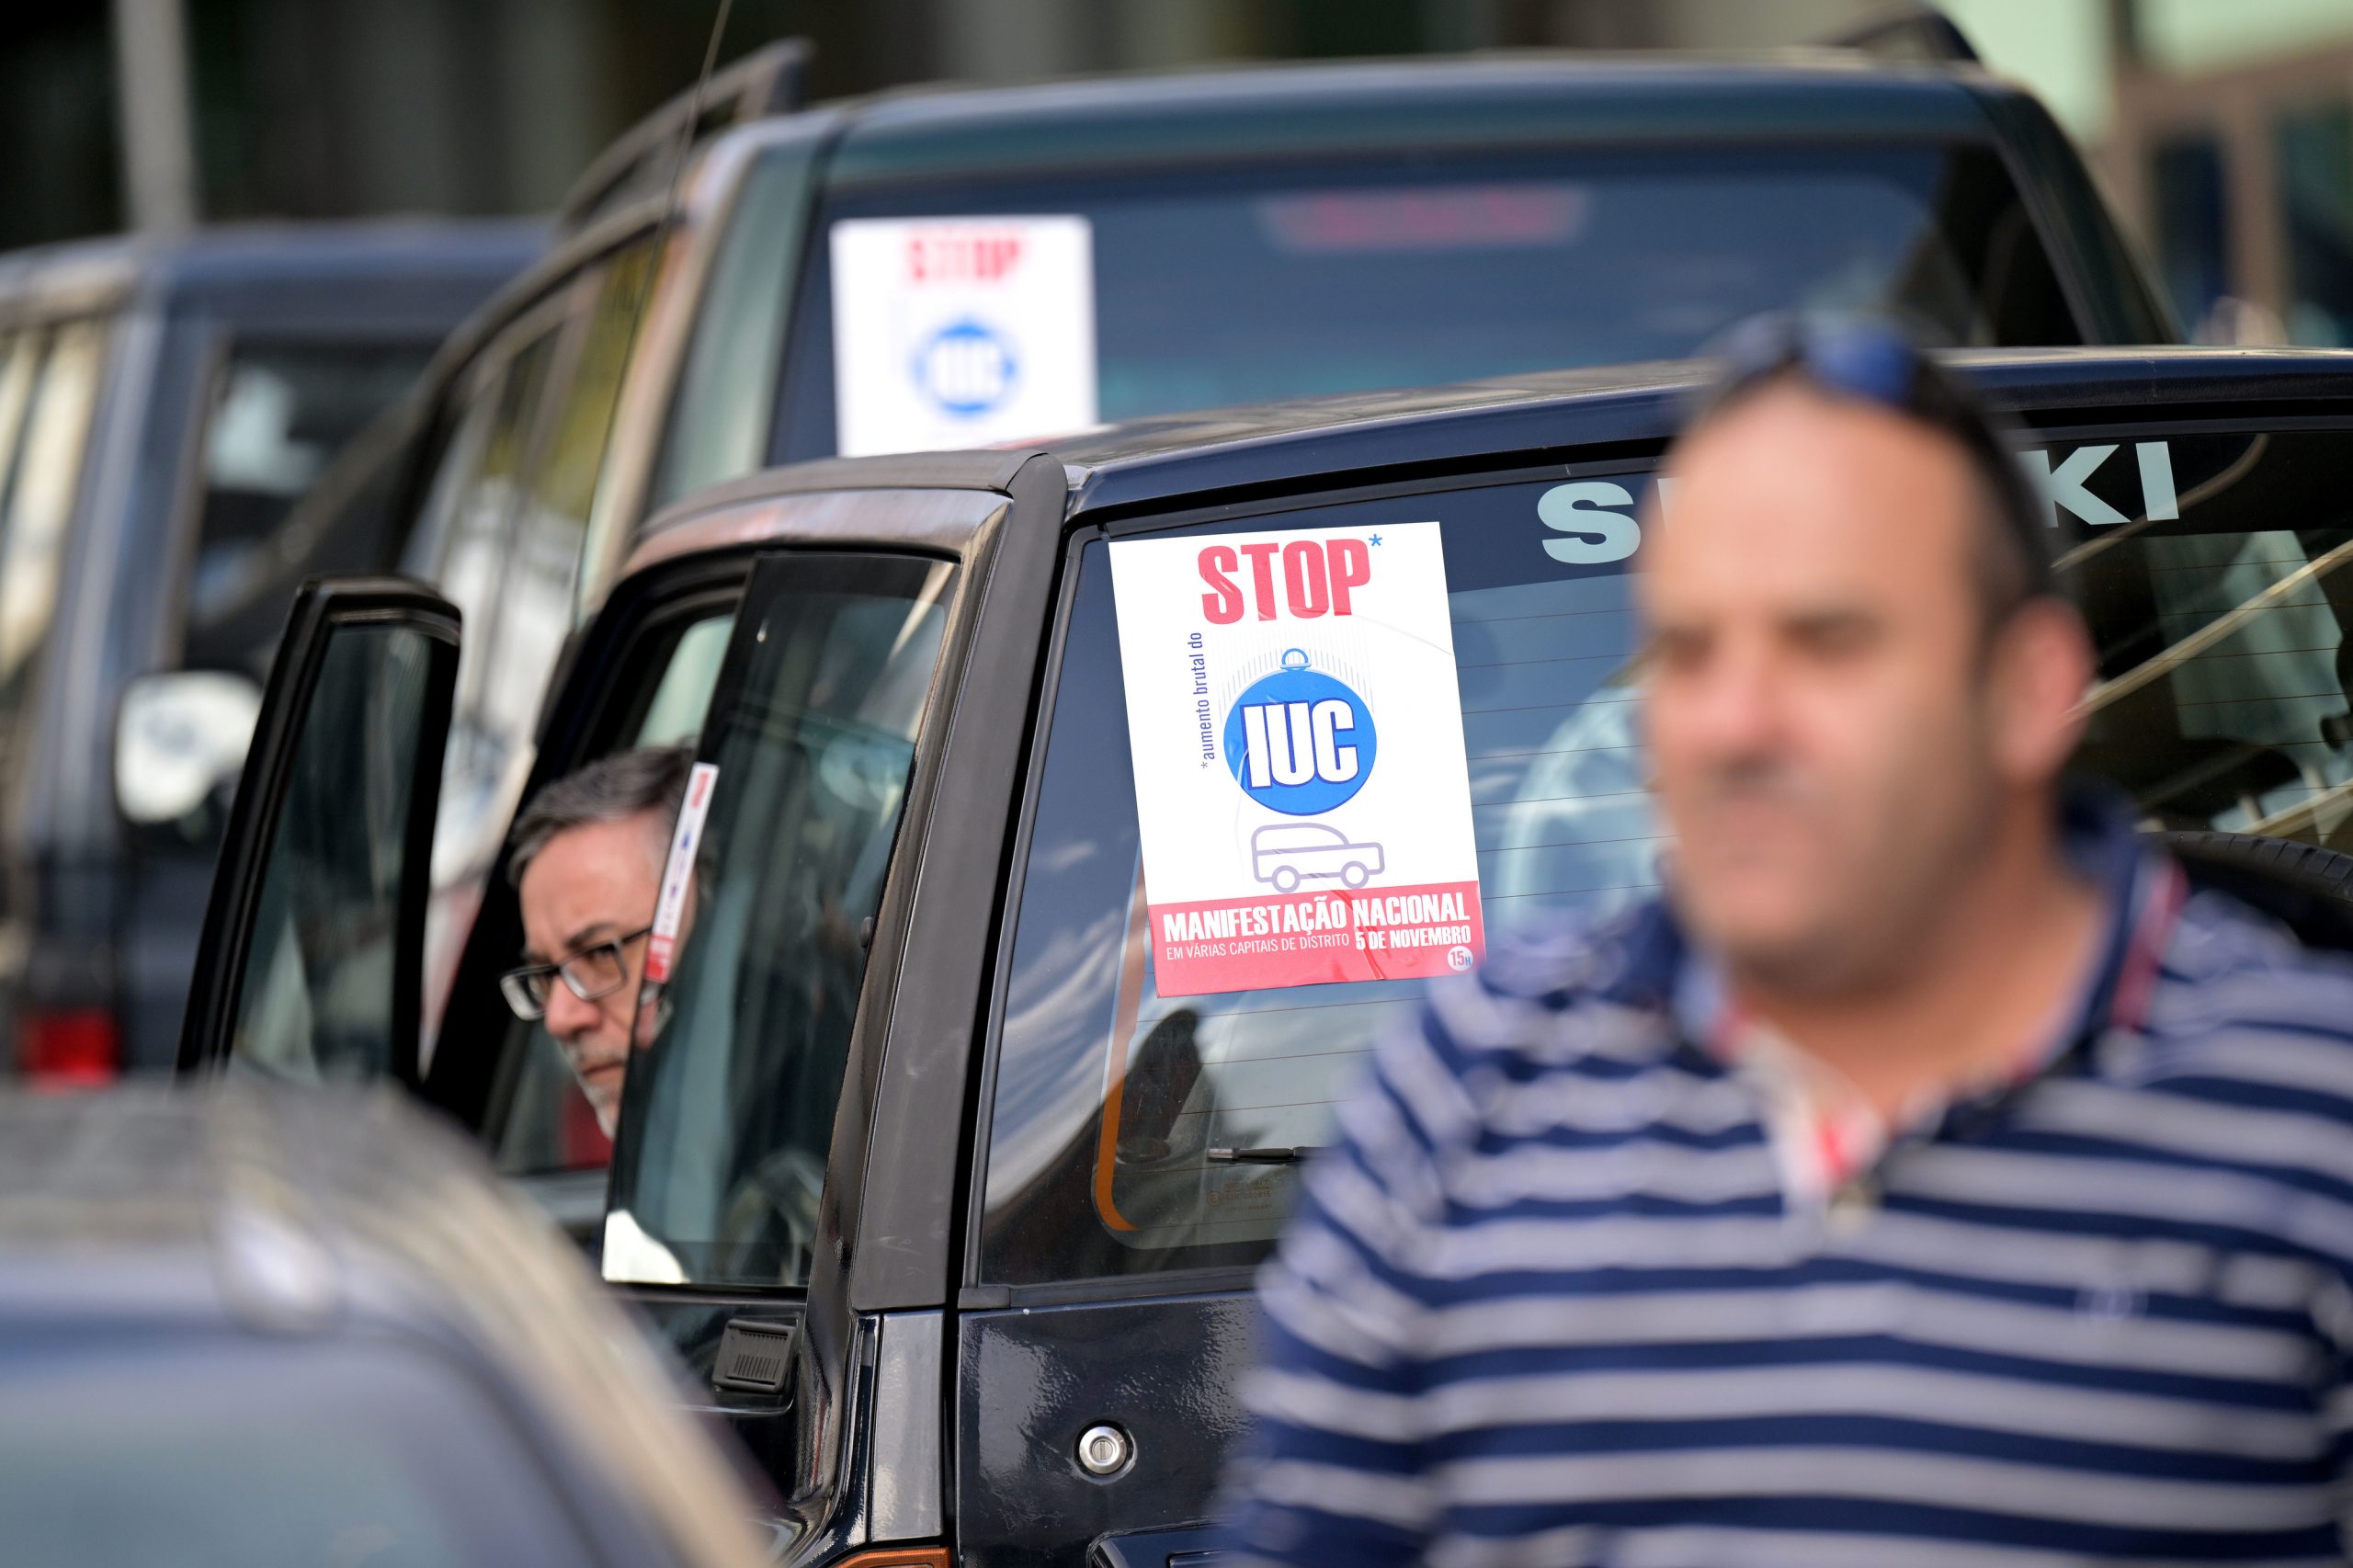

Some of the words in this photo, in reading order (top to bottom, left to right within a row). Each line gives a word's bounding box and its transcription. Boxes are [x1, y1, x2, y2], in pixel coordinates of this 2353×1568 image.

[1537, 440, 2179, 565] SKI
[1188, 632, 1203, 649] do
[1188, 653, 1208, 695] brutal
[1239, 697, 1359, 790] IUC
[1163, 895, 1347, 943] MANIFESTAÇÃO
[1351, 892, 1471, 927] NACIONAL
[1355, 930, 1367, 950] 5
[1368, 930, 1387, 950] DE
[1390, 925, 1472, 949] NOVEMBRO
[1166, 947, 1184, 960] EM
[1187, 942, 1227, 959] VÁRIAS
[1229, 938, 1279, 955] CAPITAIS
[1281, 937, 1297, 951] DE
[1300, 933, 1350, 950] DISTRITO
